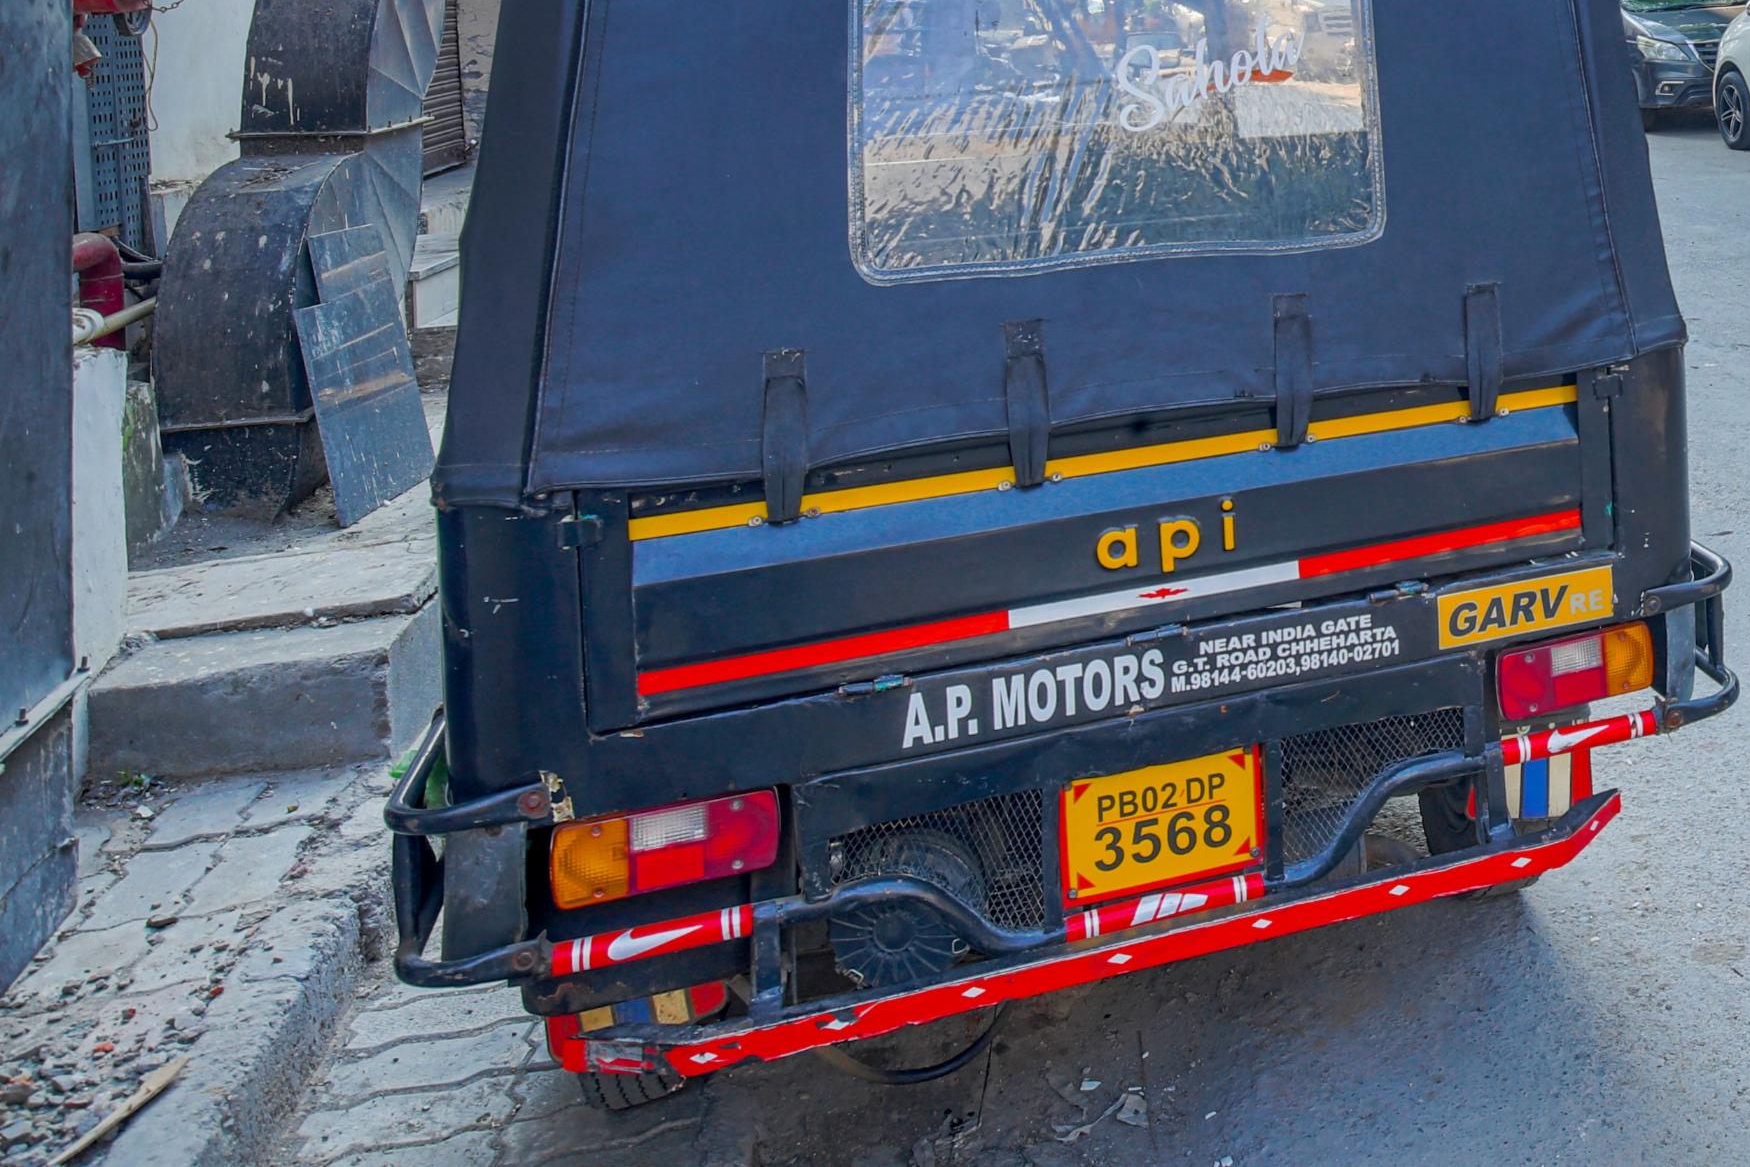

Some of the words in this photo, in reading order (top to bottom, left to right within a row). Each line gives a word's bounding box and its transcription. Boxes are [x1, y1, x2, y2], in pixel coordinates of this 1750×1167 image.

[1096, 497, 1236, 574] api
[1199, 635, 1256, 655] NEAR
[1261, 624, 1314, 645] INDIA
[1321, 614, 1372, 635] GATE
[1448, 585, 1569, 638] GARV
[1569, 588, 1605, 616] RE
[1171, 639, 1400, 694] M.98144-60203,98140-02701
[1172, 657, 1211, 675] G.T.
[1216, 647, 1271, 669] ROAD
[1277, 625, 1397, 658] CHHEHARTA
[902, 684, 979, 749] A.P.
[992, 648, 1166, 731] MOTORS
[1097, 782, 1178, 823] PB02
[1185, 772, 1225, 805] DP
[1094, 803, 1233, 872] 3568
